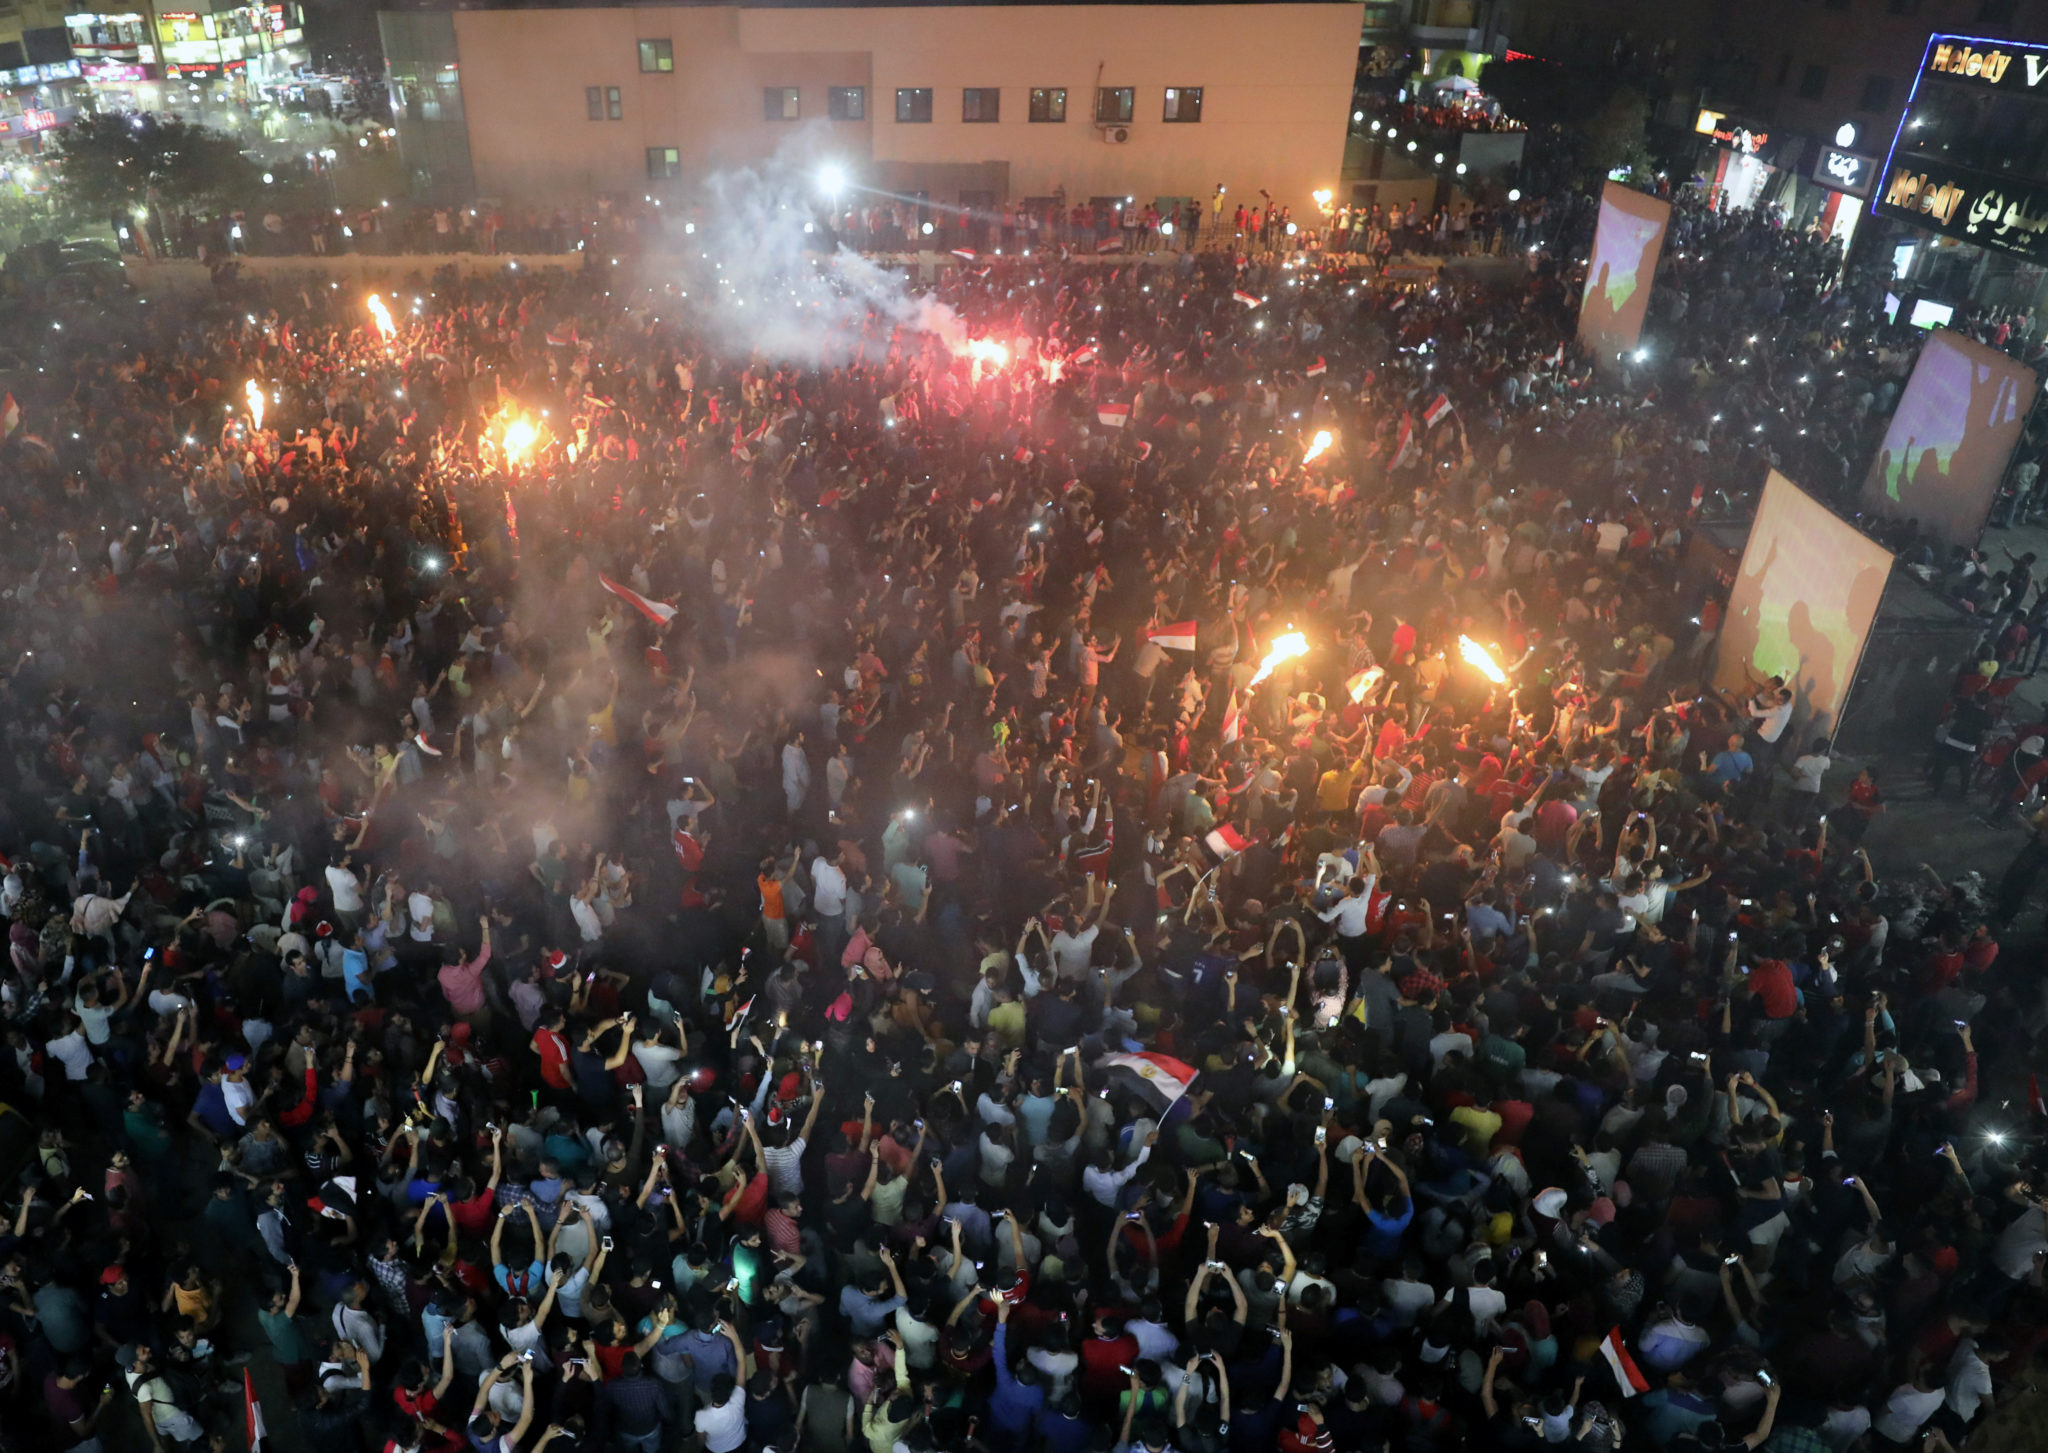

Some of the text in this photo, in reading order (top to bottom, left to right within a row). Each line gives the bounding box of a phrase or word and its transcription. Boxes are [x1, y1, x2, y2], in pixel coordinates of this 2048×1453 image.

[1931, 44, 2012, 83] Melody
[1885, 168, 1965, 226] Melody
[1193, 968, 1203, 984] 7
